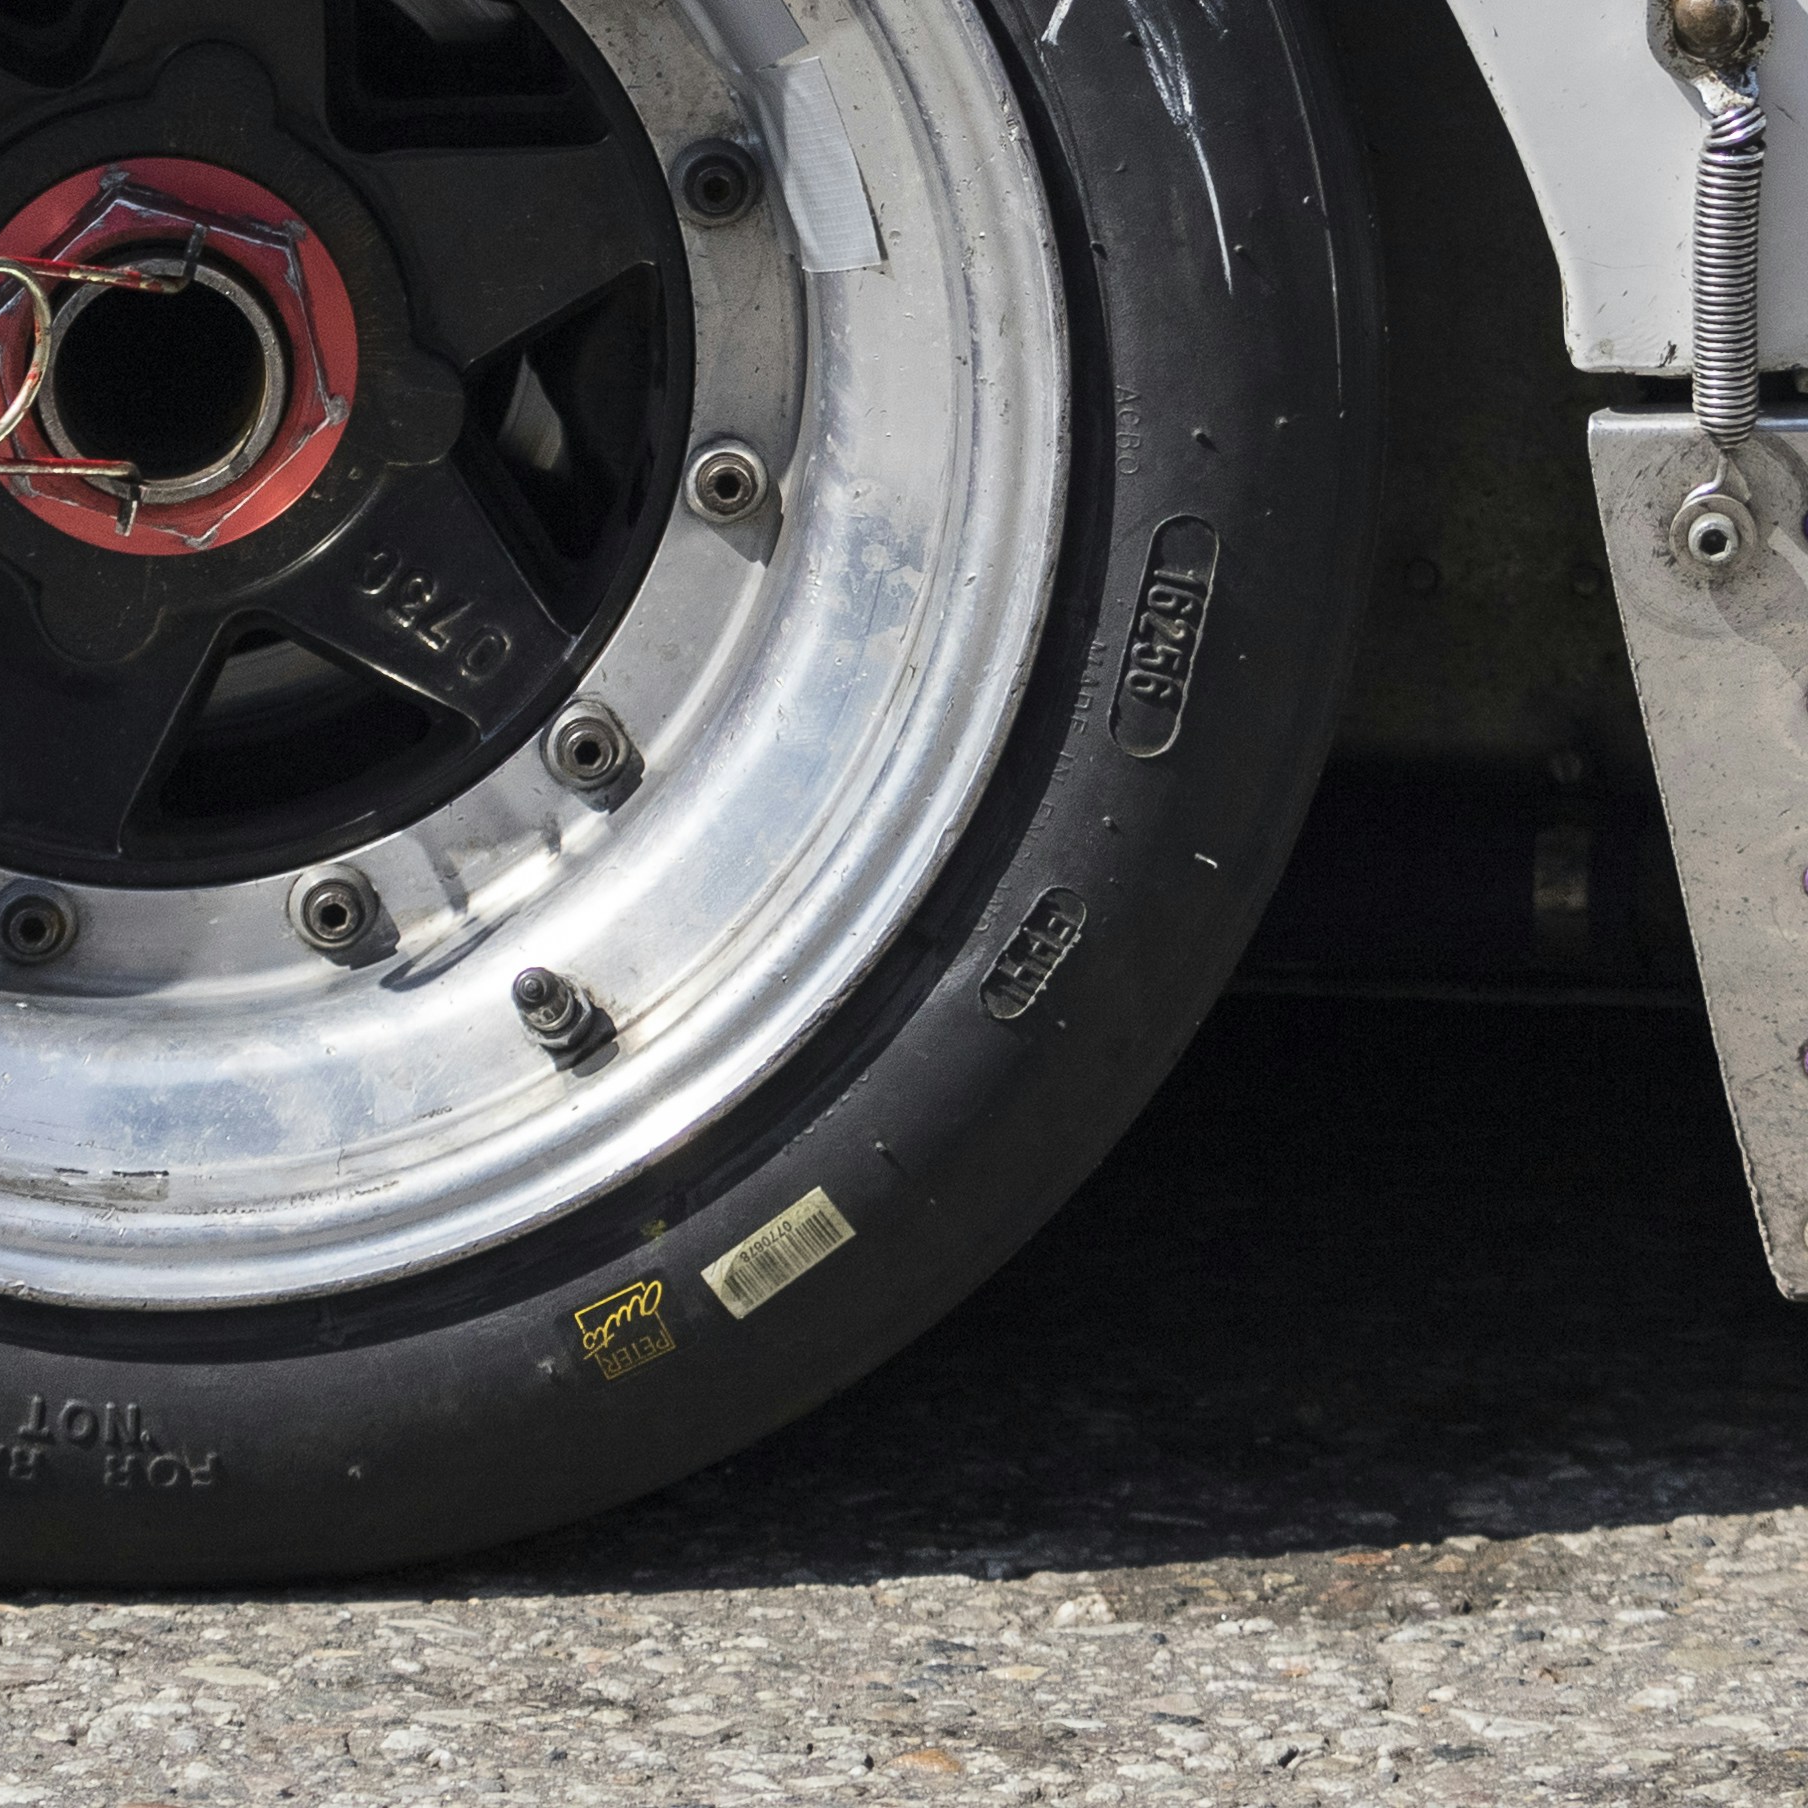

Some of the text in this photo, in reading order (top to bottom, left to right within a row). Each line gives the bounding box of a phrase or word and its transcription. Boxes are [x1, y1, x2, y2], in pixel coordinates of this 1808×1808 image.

[1125, 568, 1207, 700] 16256
[583, 1280, 663, 1360] auto
[601, 1329, 669, 1375] PETER
[18, 1394, 140, 1445] NOT
[104, 1451, 220, 1488] FOR
